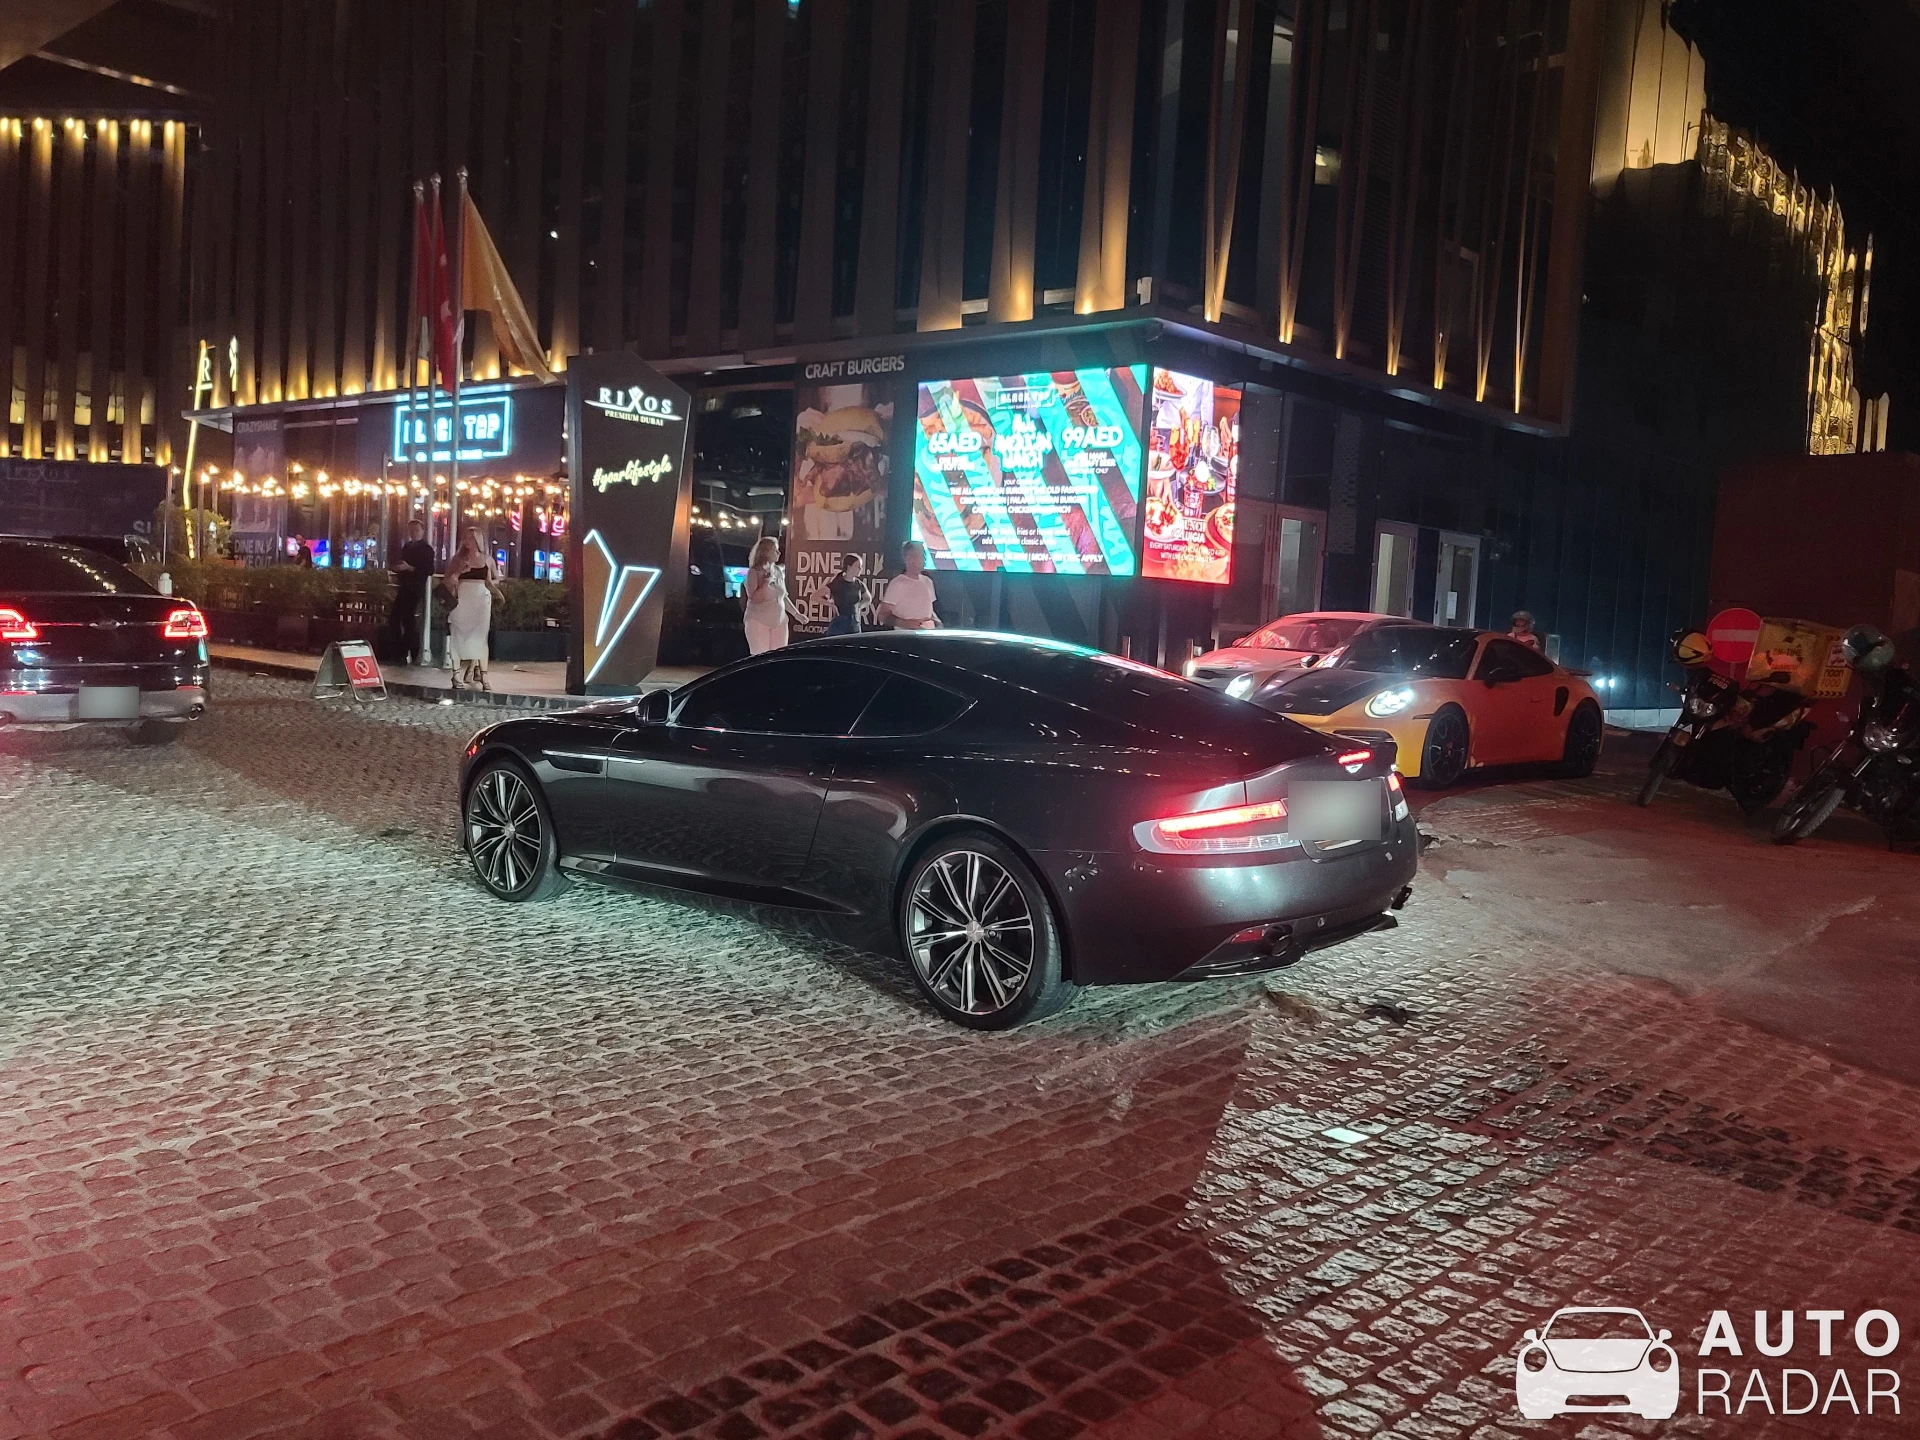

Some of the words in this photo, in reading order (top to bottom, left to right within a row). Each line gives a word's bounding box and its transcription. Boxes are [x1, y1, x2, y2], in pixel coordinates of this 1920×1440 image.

[805, 361, 845, 379] CRAFT
[847, 355, 905, 376] BURGERS
[599, 385, 673, 415] RIXOS
[463, 413, 500, 440] TAP
[605, 410, 639, 423] PREMIUM
[641, 415, 664, 427] DUBAI
[1062, 427, 1123, 448] 99AED
[592, 454, 673, 493] #yourlifestyle
[234, 539, 254, 554] DINE
[255, 554, 273, 569] OUT
[797, 551, 842, 574] DINE
[796, 575, 834, 597] TAK
